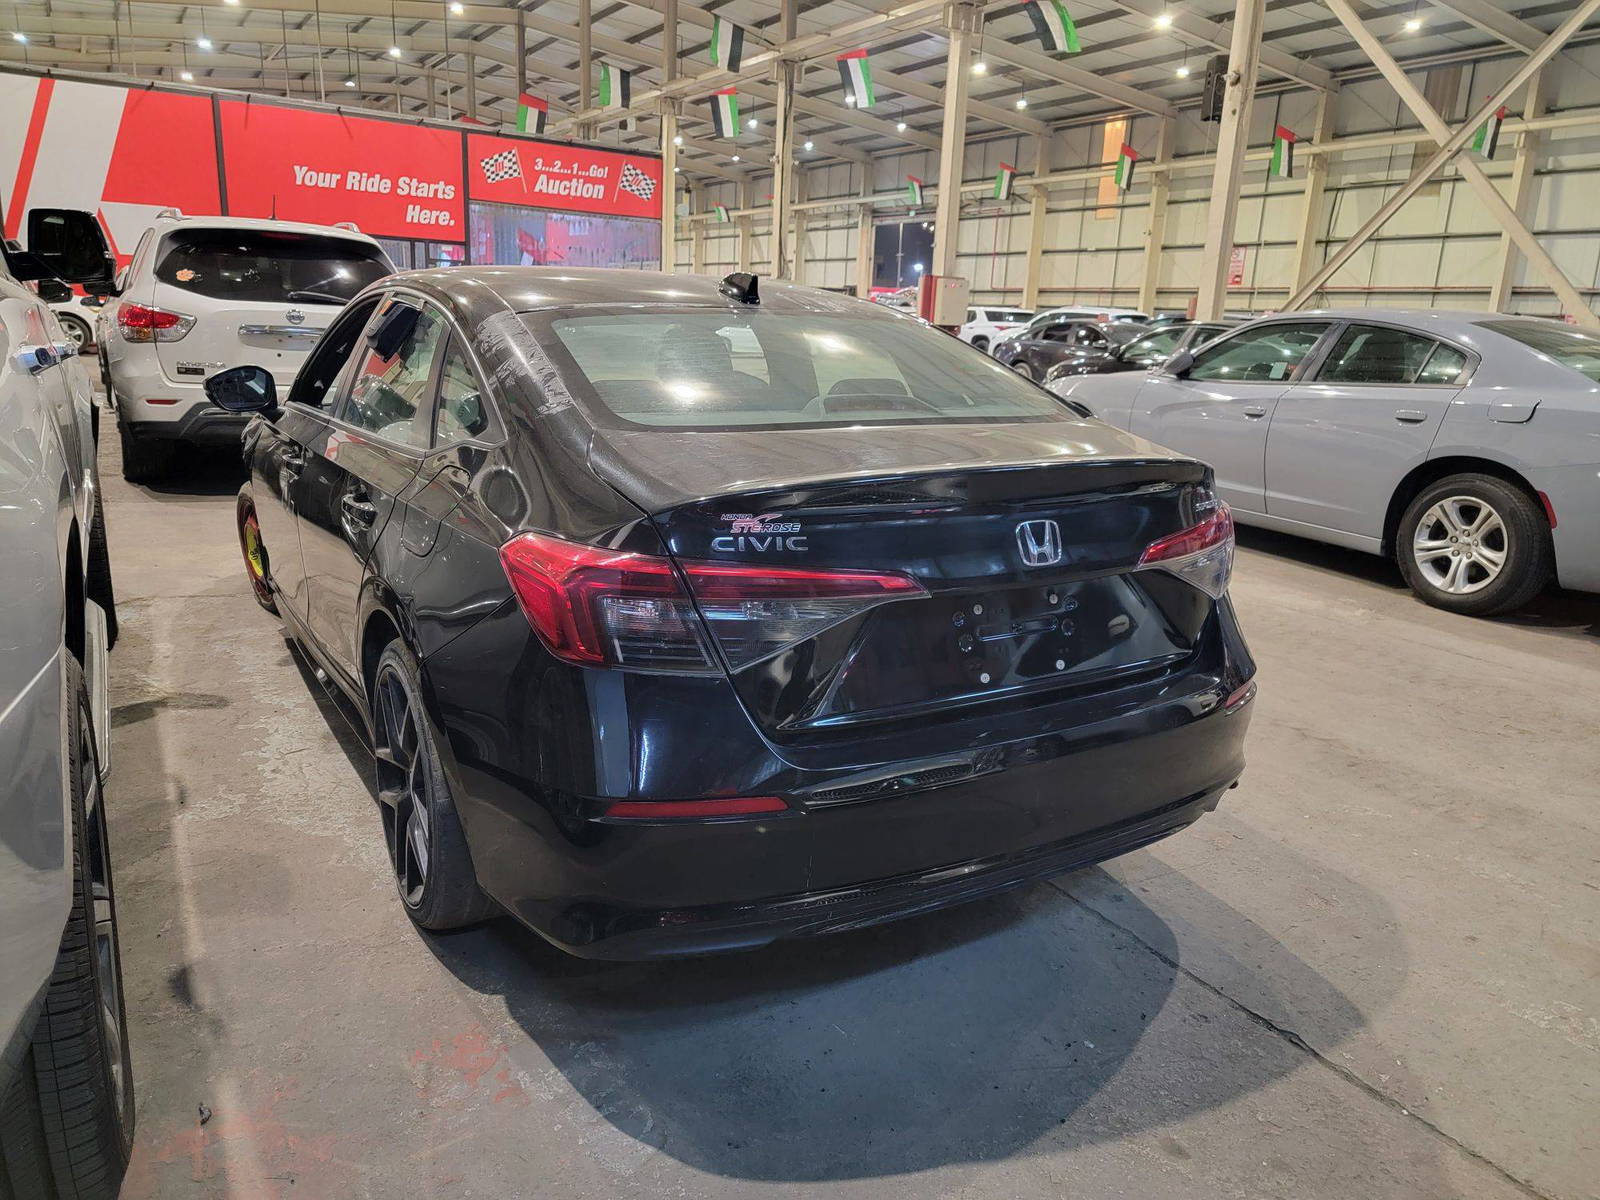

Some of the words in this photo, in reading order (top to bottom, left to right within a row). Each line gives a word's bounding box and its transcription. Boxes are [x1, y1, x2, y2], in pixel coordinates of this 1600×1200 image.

[293, 165, 341, 189] Your
[346, 171, 392, 194] Ride
[397, 176, 455, 200] Starts
[534, 174, 605, 199] Auction
[406, 204, 455, 226] Here.
[711, 536, 808, 552] CIVIC
